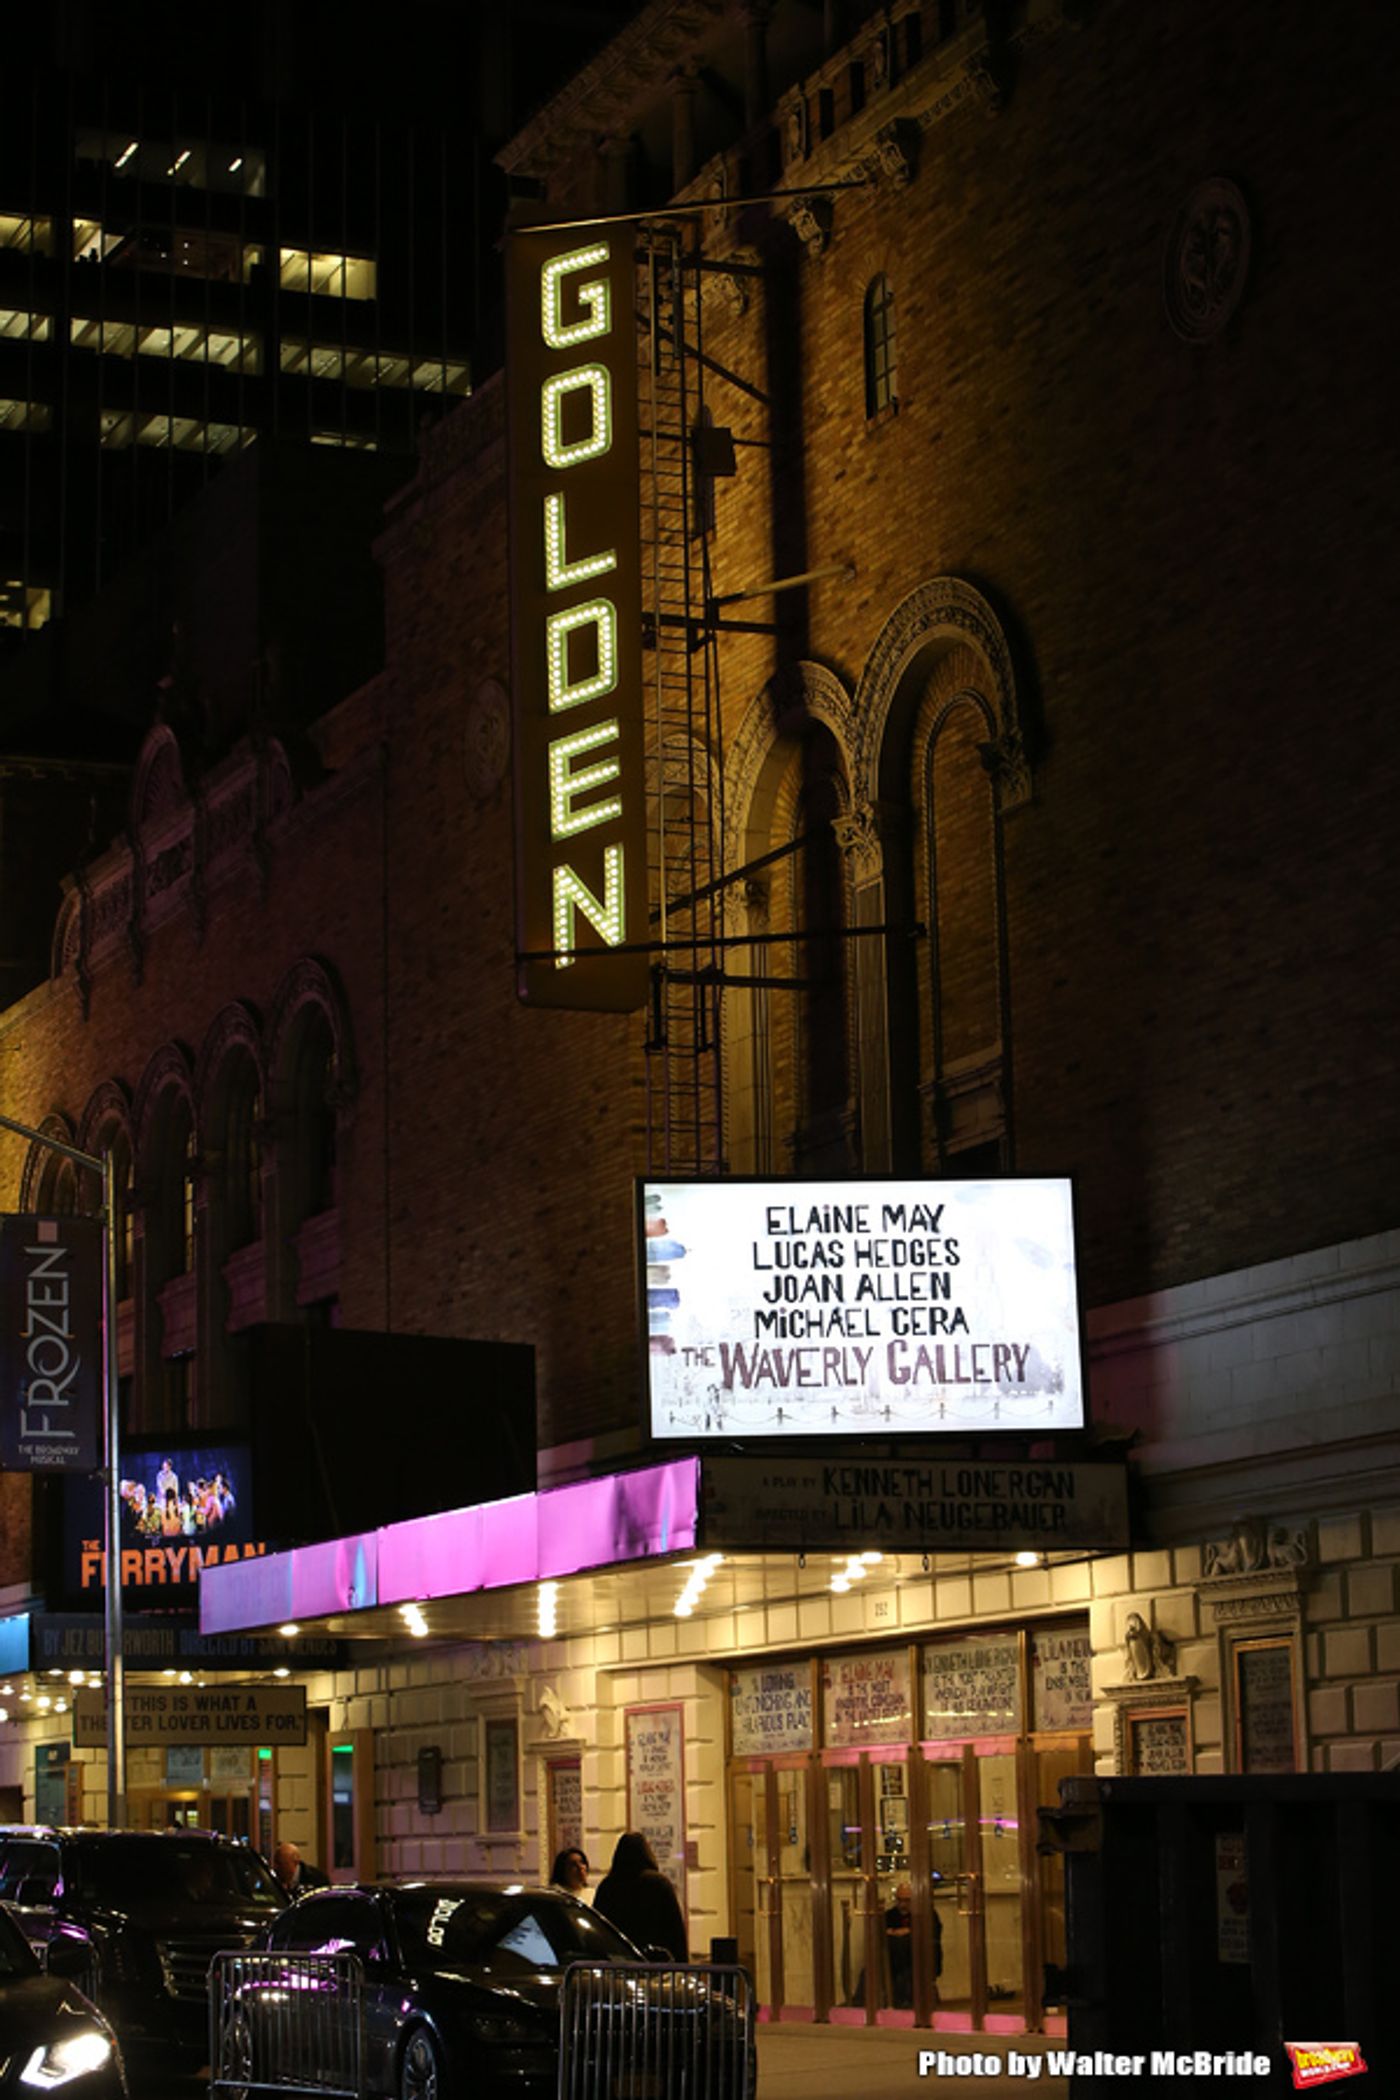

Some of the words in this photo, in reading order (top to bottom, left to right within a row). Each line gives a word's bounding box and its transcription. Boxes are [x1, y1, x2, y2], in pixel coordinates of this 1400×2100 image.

[541, 240, 626, 971] GOLDEN
[766, 1205, 870, 1236] ELAINE
[881, 1203, 945, 1234] MAY
[753, 1239, 845, 1270] LUCAS
[855, 1238, 960, 1268] HEDGES
[763, 1273, 844, 1303] JOAN
[856, 1272, 951, 1301] ALLEN
[754, 1307, 881, 1339] MICHAEL
[891, 1307, 970, 1337] CERA
[21, 1246, 81, 1438] FROZEN
[681, 1346, 715, 1368] THE
[718, 1342, 874, 1390] WAVERLY
[886, 1340, 1031, 1386] GALLERY
[822, 1467, 931, 1499] KENNETH
[941, 1469, 1075, 1500] LONERGAN
[833, 1500, 893, 1529] LILA
[903, 1501, 1067, 1532] NEUGEBAUER
[82, 1540, 100, 1550] THE
[81, 1542, 266, 1588] FRRYM
[86, 1629, 174, 1656] BURWORTH
[131, 1696, 168, 1712] THIS
[172, 1696, 188, 1712] IS
[195, 1696, 241, 1712] WHAT
[245, 1695, 257, 1711] A
[80, 1715, 153, 1731] THETER
[158, 1714, 211, 1731] LOVER
[216, 1714, 260, 1731] LIVES
